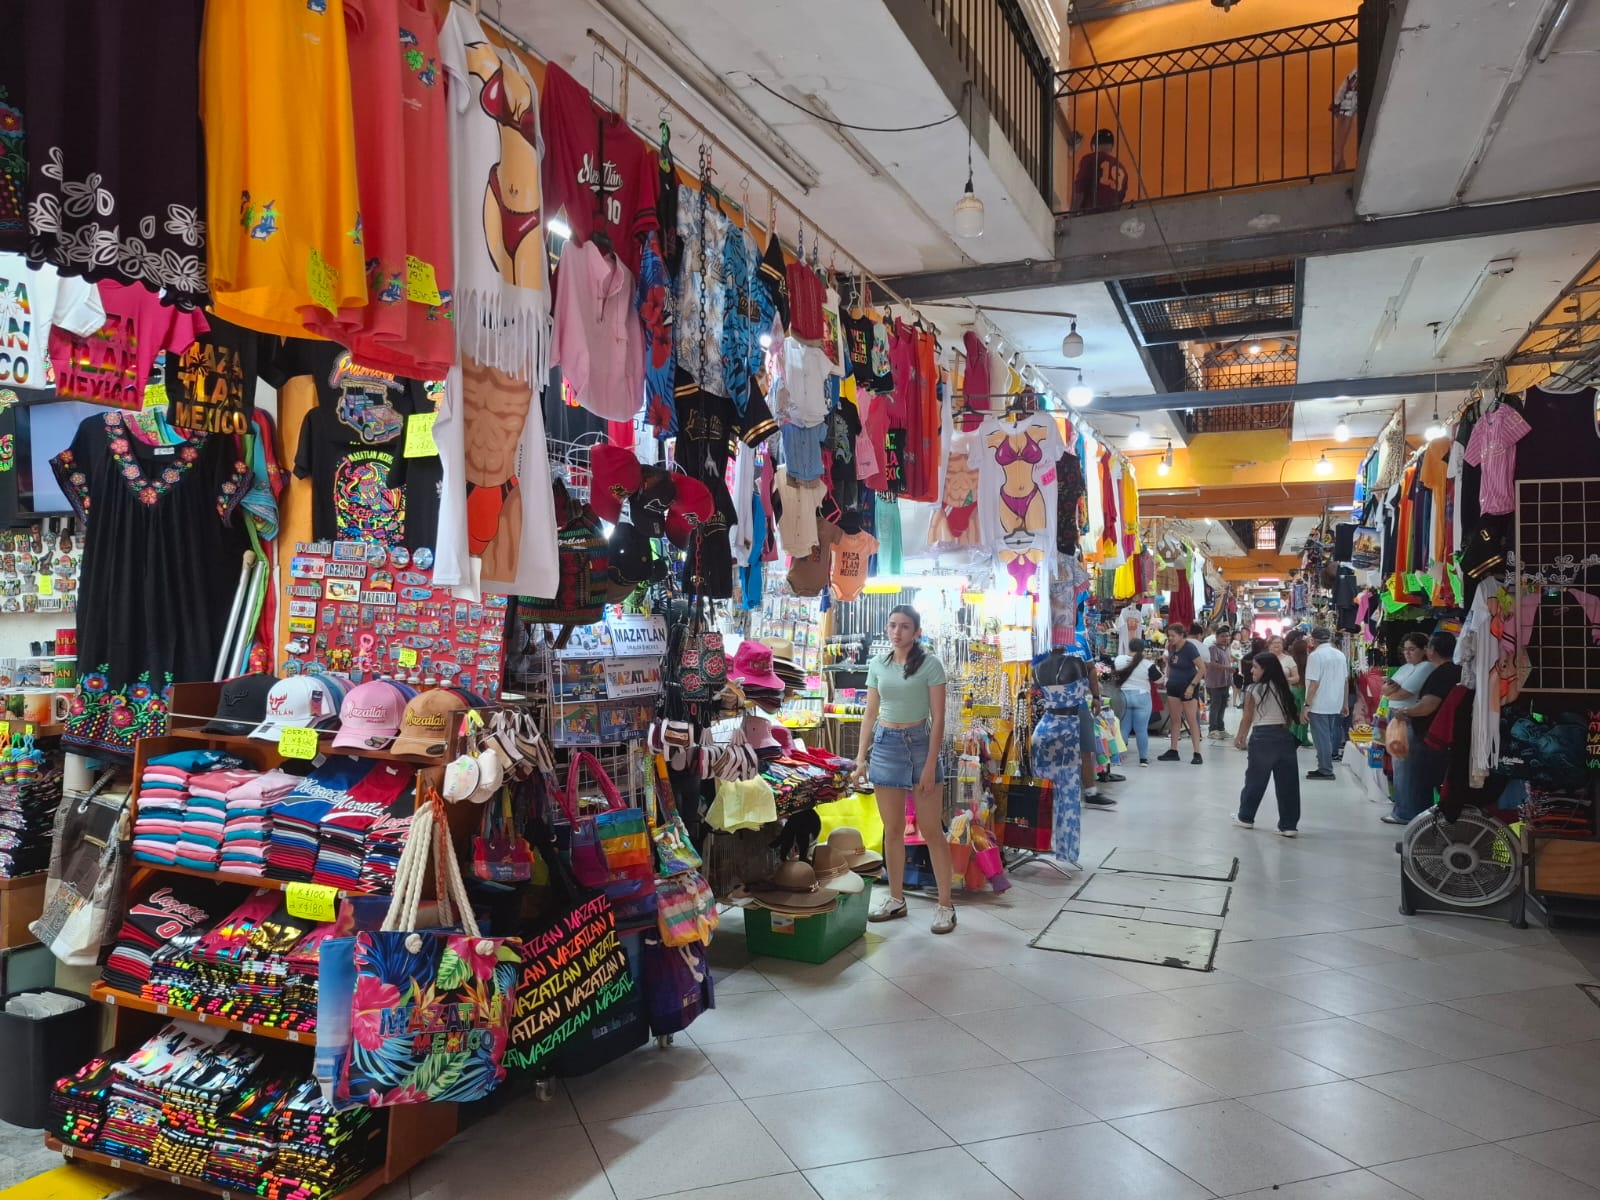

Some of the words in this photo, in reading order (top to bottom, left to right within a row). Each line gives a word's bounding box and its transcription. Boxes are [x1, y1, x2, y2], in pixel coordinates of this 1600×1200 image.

[607, 196, 621, 225] 10
[547, 917, 607, 971] MAZATLAN
[564, 956, 619, 1011] MAZATLAN
